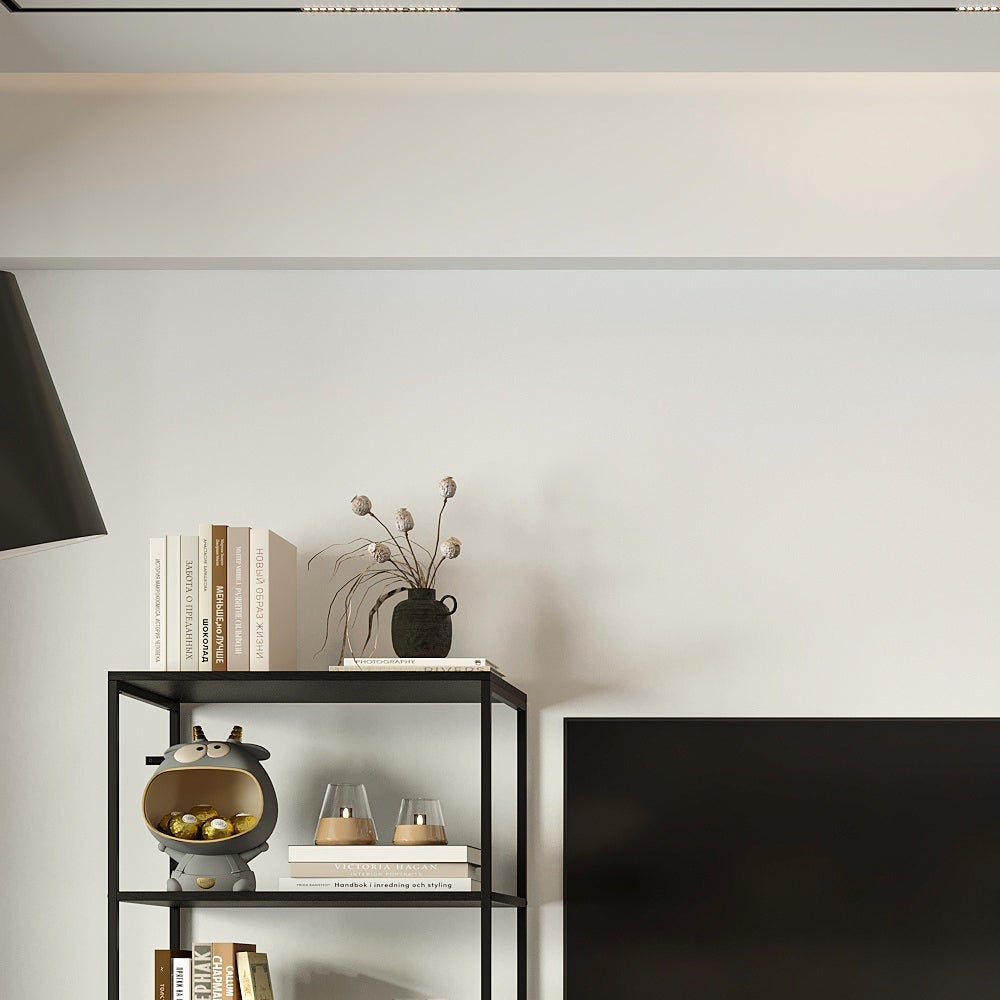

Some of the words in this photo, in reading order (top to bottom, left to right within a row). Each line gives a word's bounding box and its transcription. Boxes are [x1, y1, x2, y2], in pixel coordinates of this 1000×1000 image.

[185, 560, 193, 593] ЗАБОТА
[256, 548, 265, 585] НОВЫЙ
[256, 587, 264, 619] ОБРАЗ
[184, 604, 193, 660] ПРЕДАННЫХ
[256, 623, 264, 659] ЖИЗНИ
[215, 635, 224, 664] ЛУЧШЕ
[373, 881, 409, 890] inredning
[427, 881, 452, 890] styling
[225, 965, 234, 997] CALLUM
